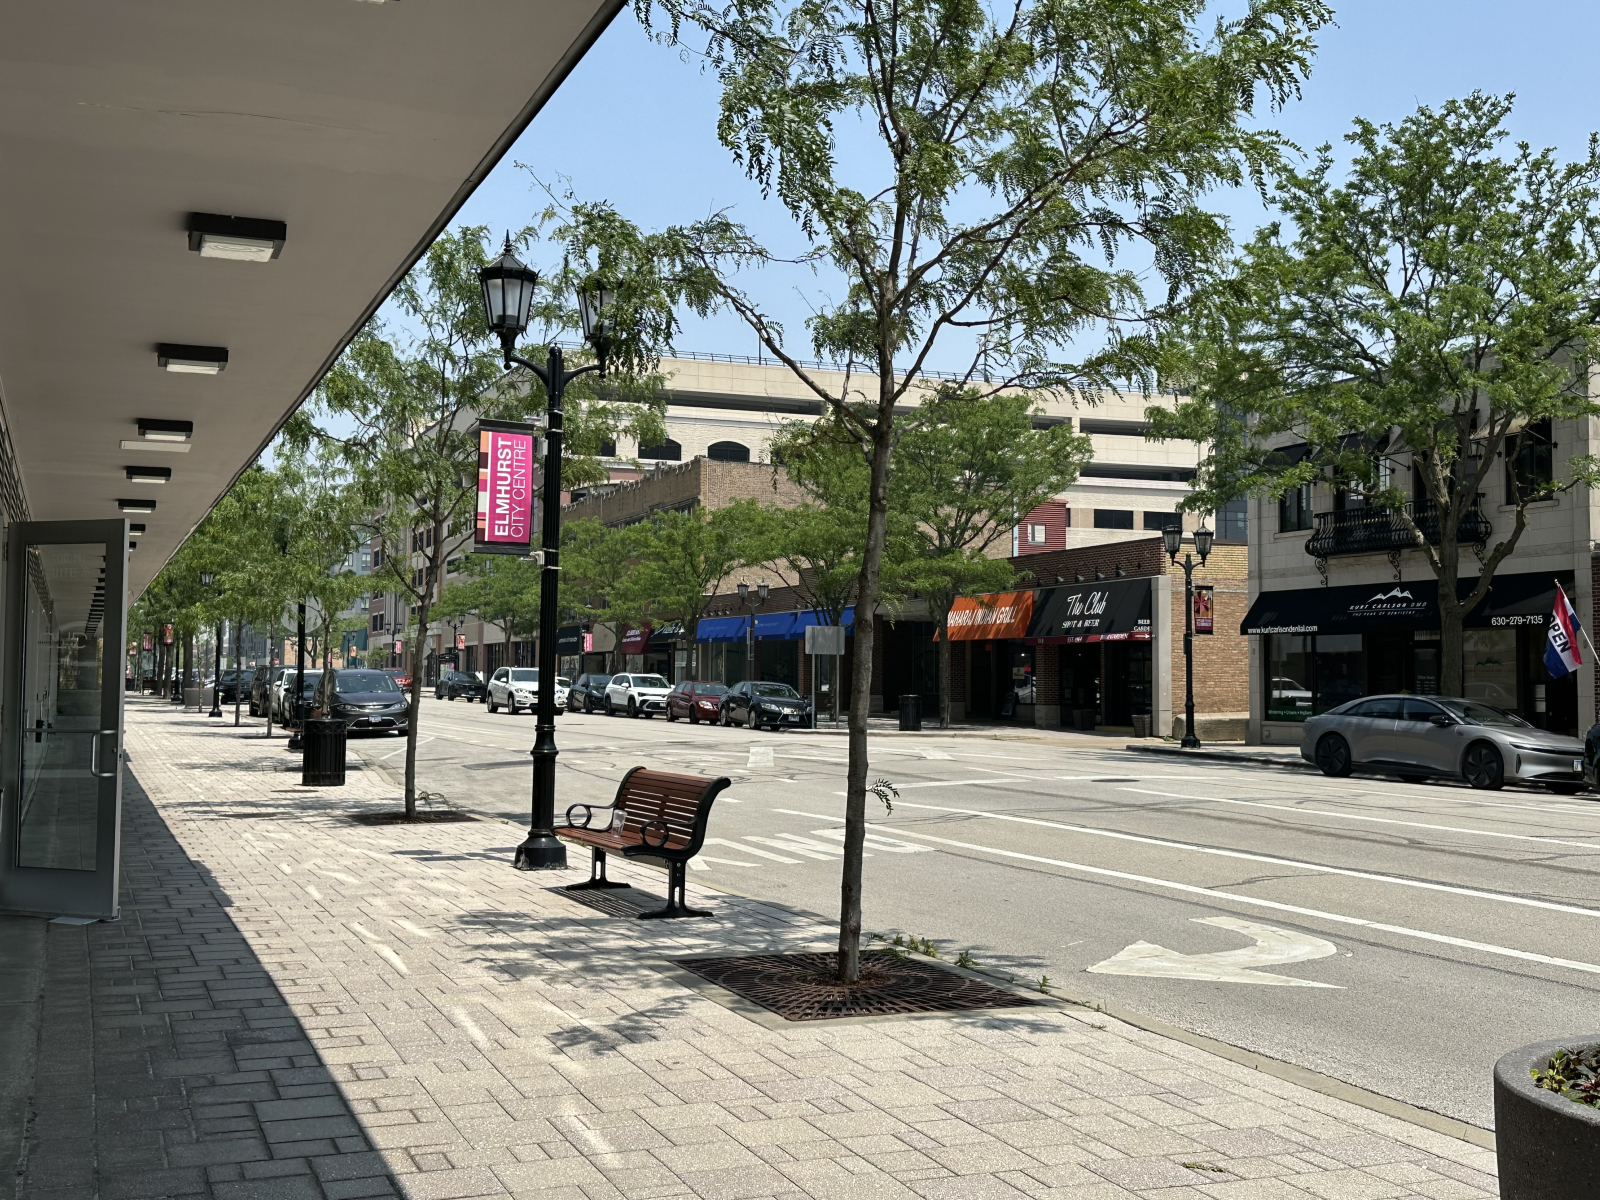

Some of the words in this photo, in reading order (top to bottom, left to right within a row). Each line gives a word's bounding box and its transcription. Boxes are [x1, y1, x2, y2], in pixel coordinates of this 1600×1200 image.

[512, 439, 527, 500] CENTRE
[494, 437, 512, 537] ELMHURST
[510, 504, 524, 538] CITY
[996, 605, 1017, 624] GRILL
[1067, 593, 1084, 616] The
[1084, 591, 1109, 615] Club
[1247, 624, 1318, 634] www.kurtcarlsondental.com
[1491, 615, 1543, 626] 630-279-7135
